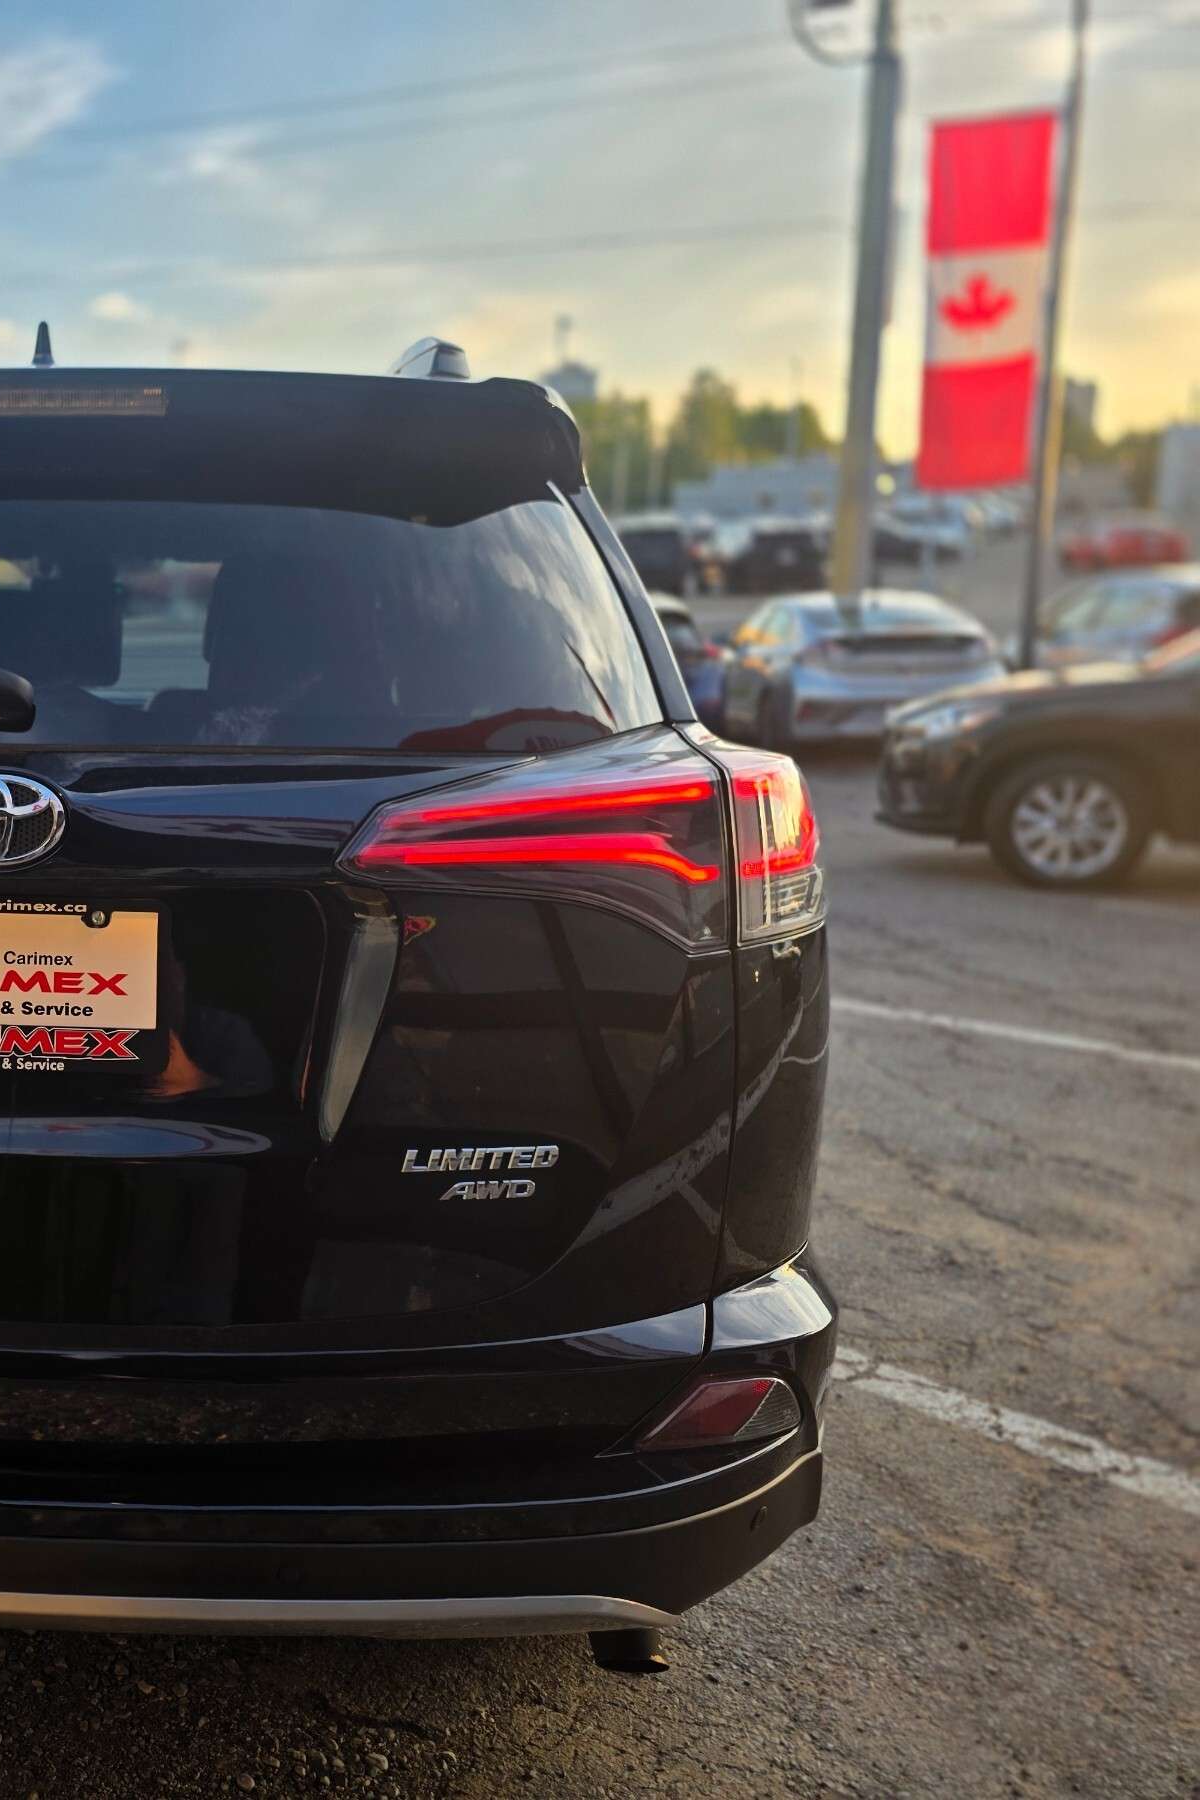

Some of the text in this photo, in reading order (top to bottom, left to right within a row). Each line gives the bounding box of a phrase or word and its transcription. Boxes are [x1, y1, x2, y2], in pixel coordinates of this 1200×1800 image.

[3, 951, 73, 966] Carimex
[0, 1001, 15, 1015] &
[21, 1002, 94, 1017] Service
[1, 1057, 13, 1070] &
[16, 1057, 65, 1071] Service
[401, 1145, 560, 1173] LIMITED
[440, 1179, 537, 1201] AWD
